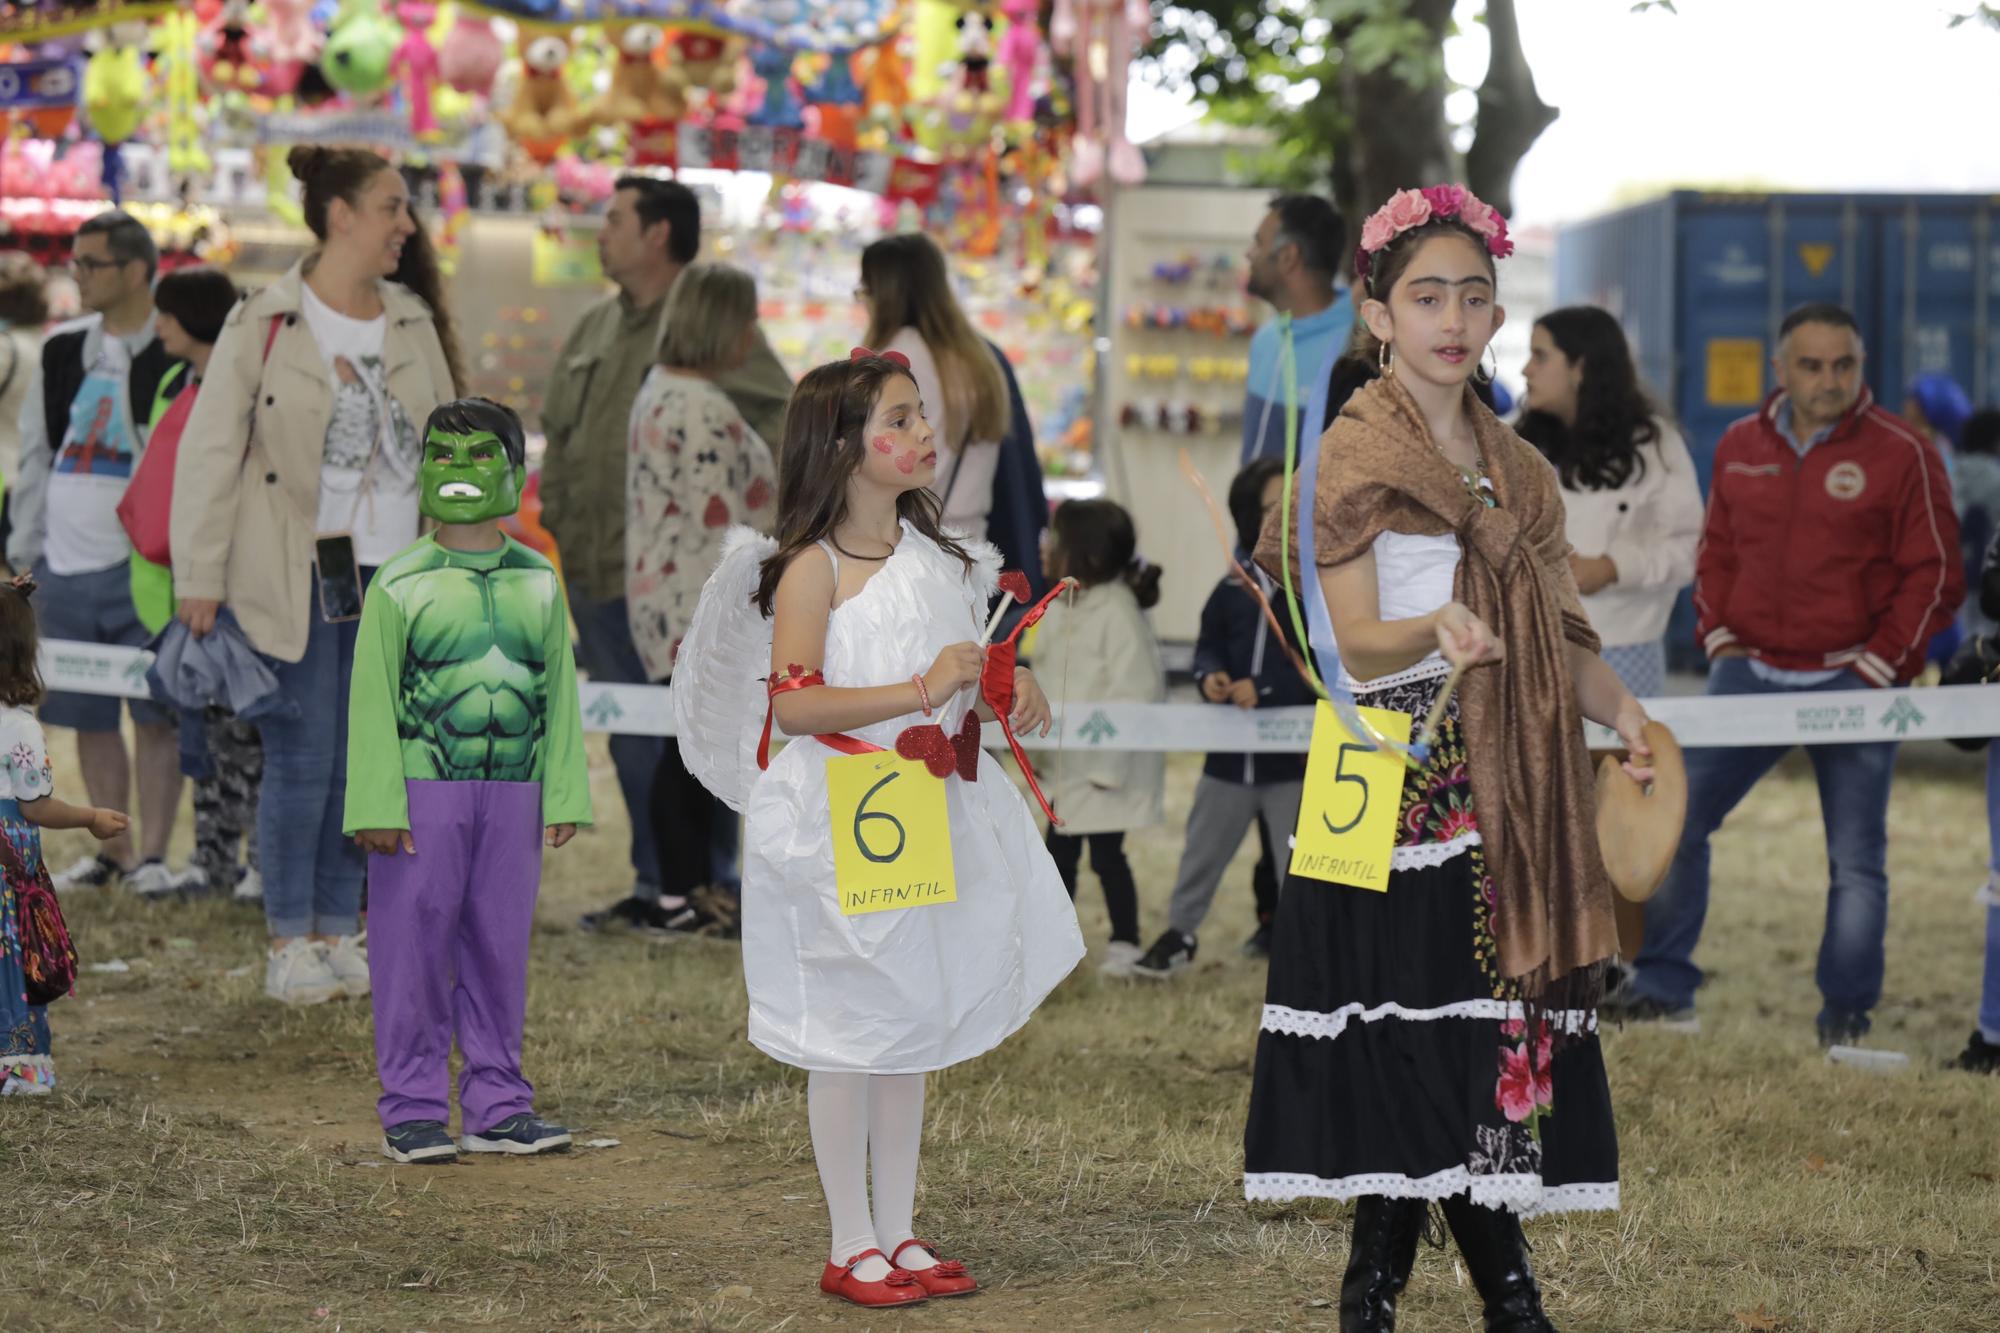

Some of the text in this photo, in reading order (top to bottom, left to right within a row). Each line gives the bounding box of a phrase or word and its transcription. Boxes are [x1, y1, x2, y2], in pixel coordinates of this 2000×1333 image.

[853, 771, 906, 864] 6
[1323, 742, 1378, 834] 5
[846, 881, 946, 908] INFANTIL
[1297, 853, 1378, 881] INFANTIL
